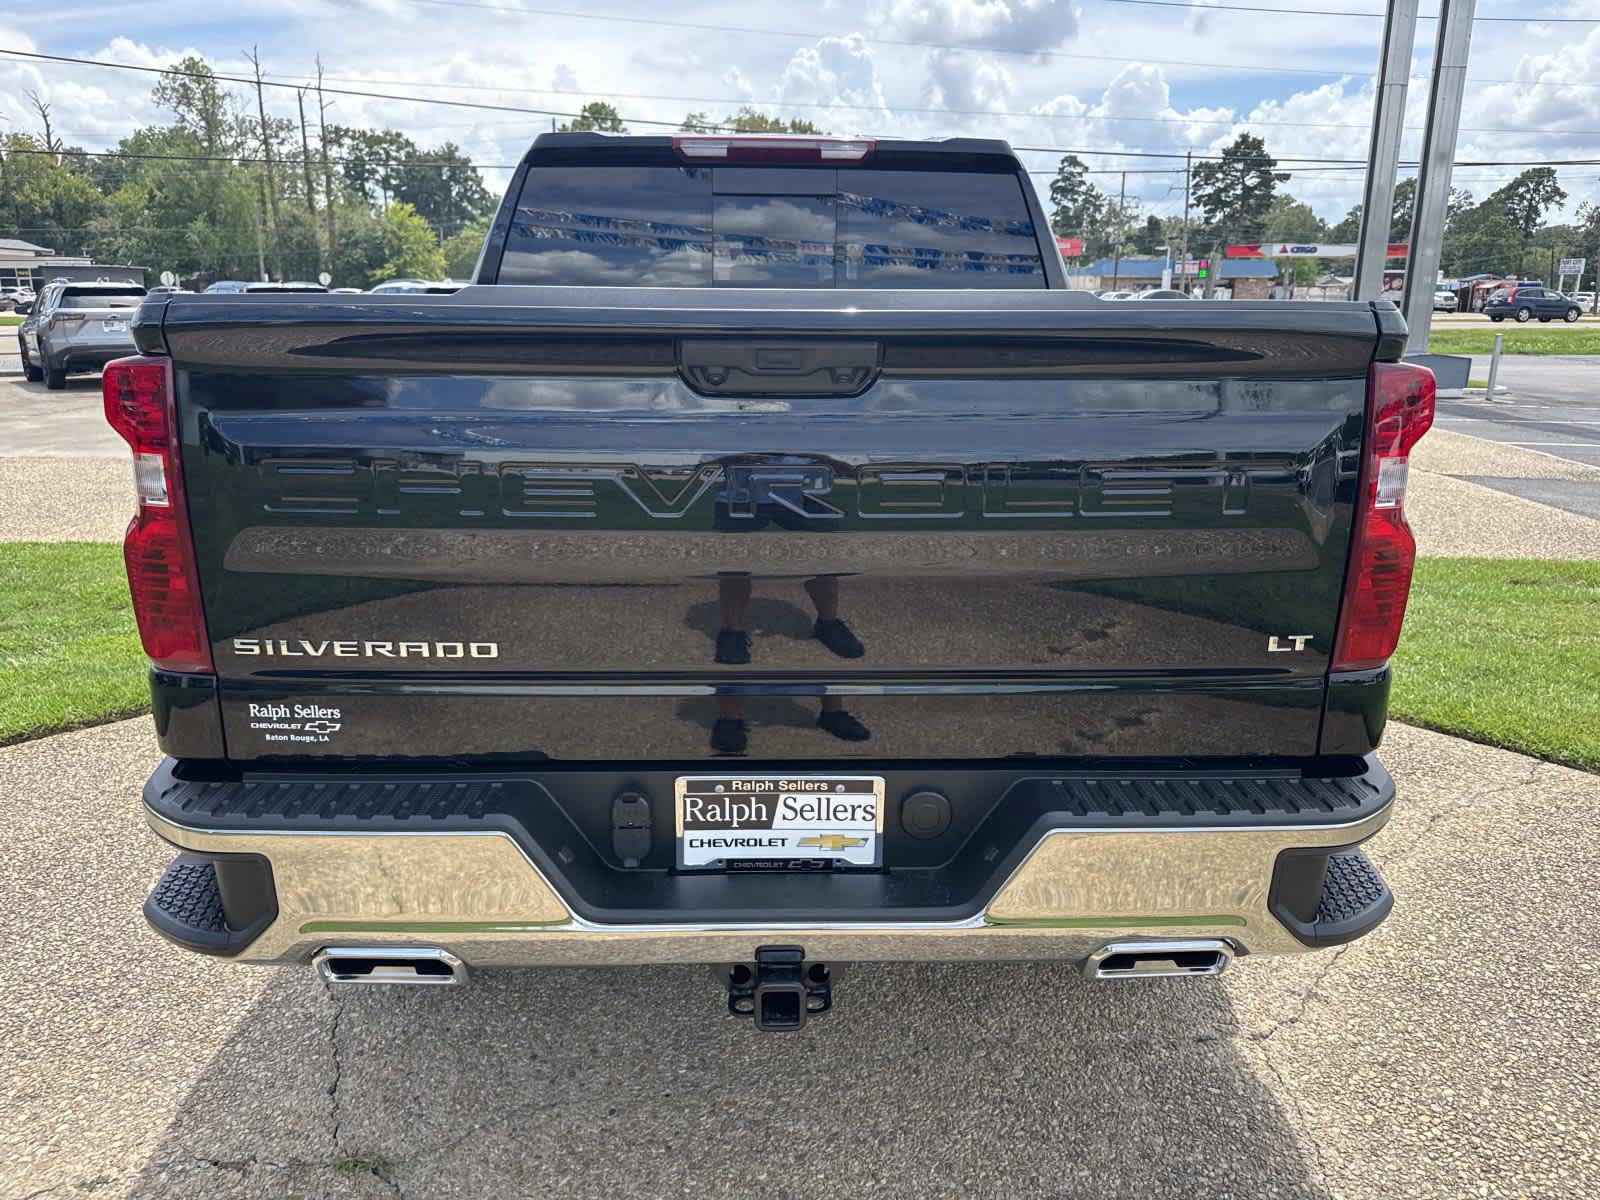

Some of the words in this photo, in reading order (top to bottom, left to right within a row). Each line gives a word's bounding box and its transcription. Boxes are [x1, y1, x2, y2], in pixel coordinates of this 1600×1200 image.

[260, 457, 1298, 518] CHEVROLET
[232, 638, 499, 659] SILVERADO
[1267, 635, 1314, 652] LT
[248, 703, 291, 720] Ralph
[294, 704, 341, 719] Sellers
[250, 722, 302, 730] CHEVROLET
[265, 733, 288, 742] Baton
[290, 734, 317, 743] Rouge,
[731, 780, 774, 792] Ralph
[778, 780, 828, 791] Sellers
[684, 797, 768, 828] Ralph
[782, 796, 876, 822] Sellers
[689, 837, 789, 849] CHEVROLET
[733, 861, 785, 869] CHEVROLET
